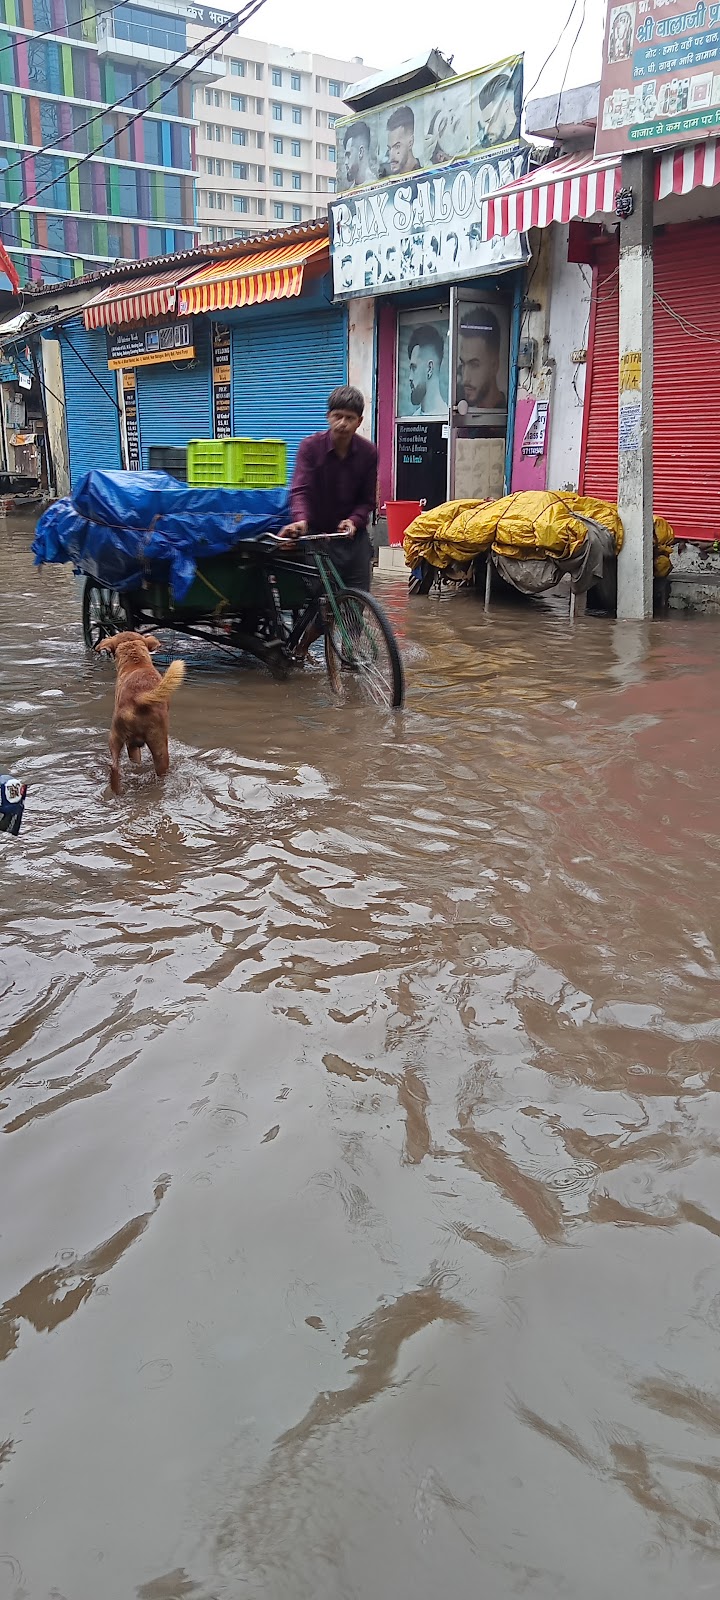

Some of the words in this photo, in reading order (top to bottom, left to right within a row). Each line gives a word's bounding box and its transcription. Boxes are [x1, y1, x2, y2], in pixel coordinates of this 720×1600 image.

[636, 15, 655, 43] श्री
[662, 42, 679, 56] हमारे
[694, 37, 704, 46] पर
[679, 52, 694, 66] आदि
[695, 48, 718, 62] सामान
[655, 122, 664, 135] से
[665, 121, 682, 133] कम
[683, 117, 699, 130] दाम
[701, 114, 714, 125] पर
[331, 192, 390, 247] RAX
[393, 154, 525, 233] SALOON
